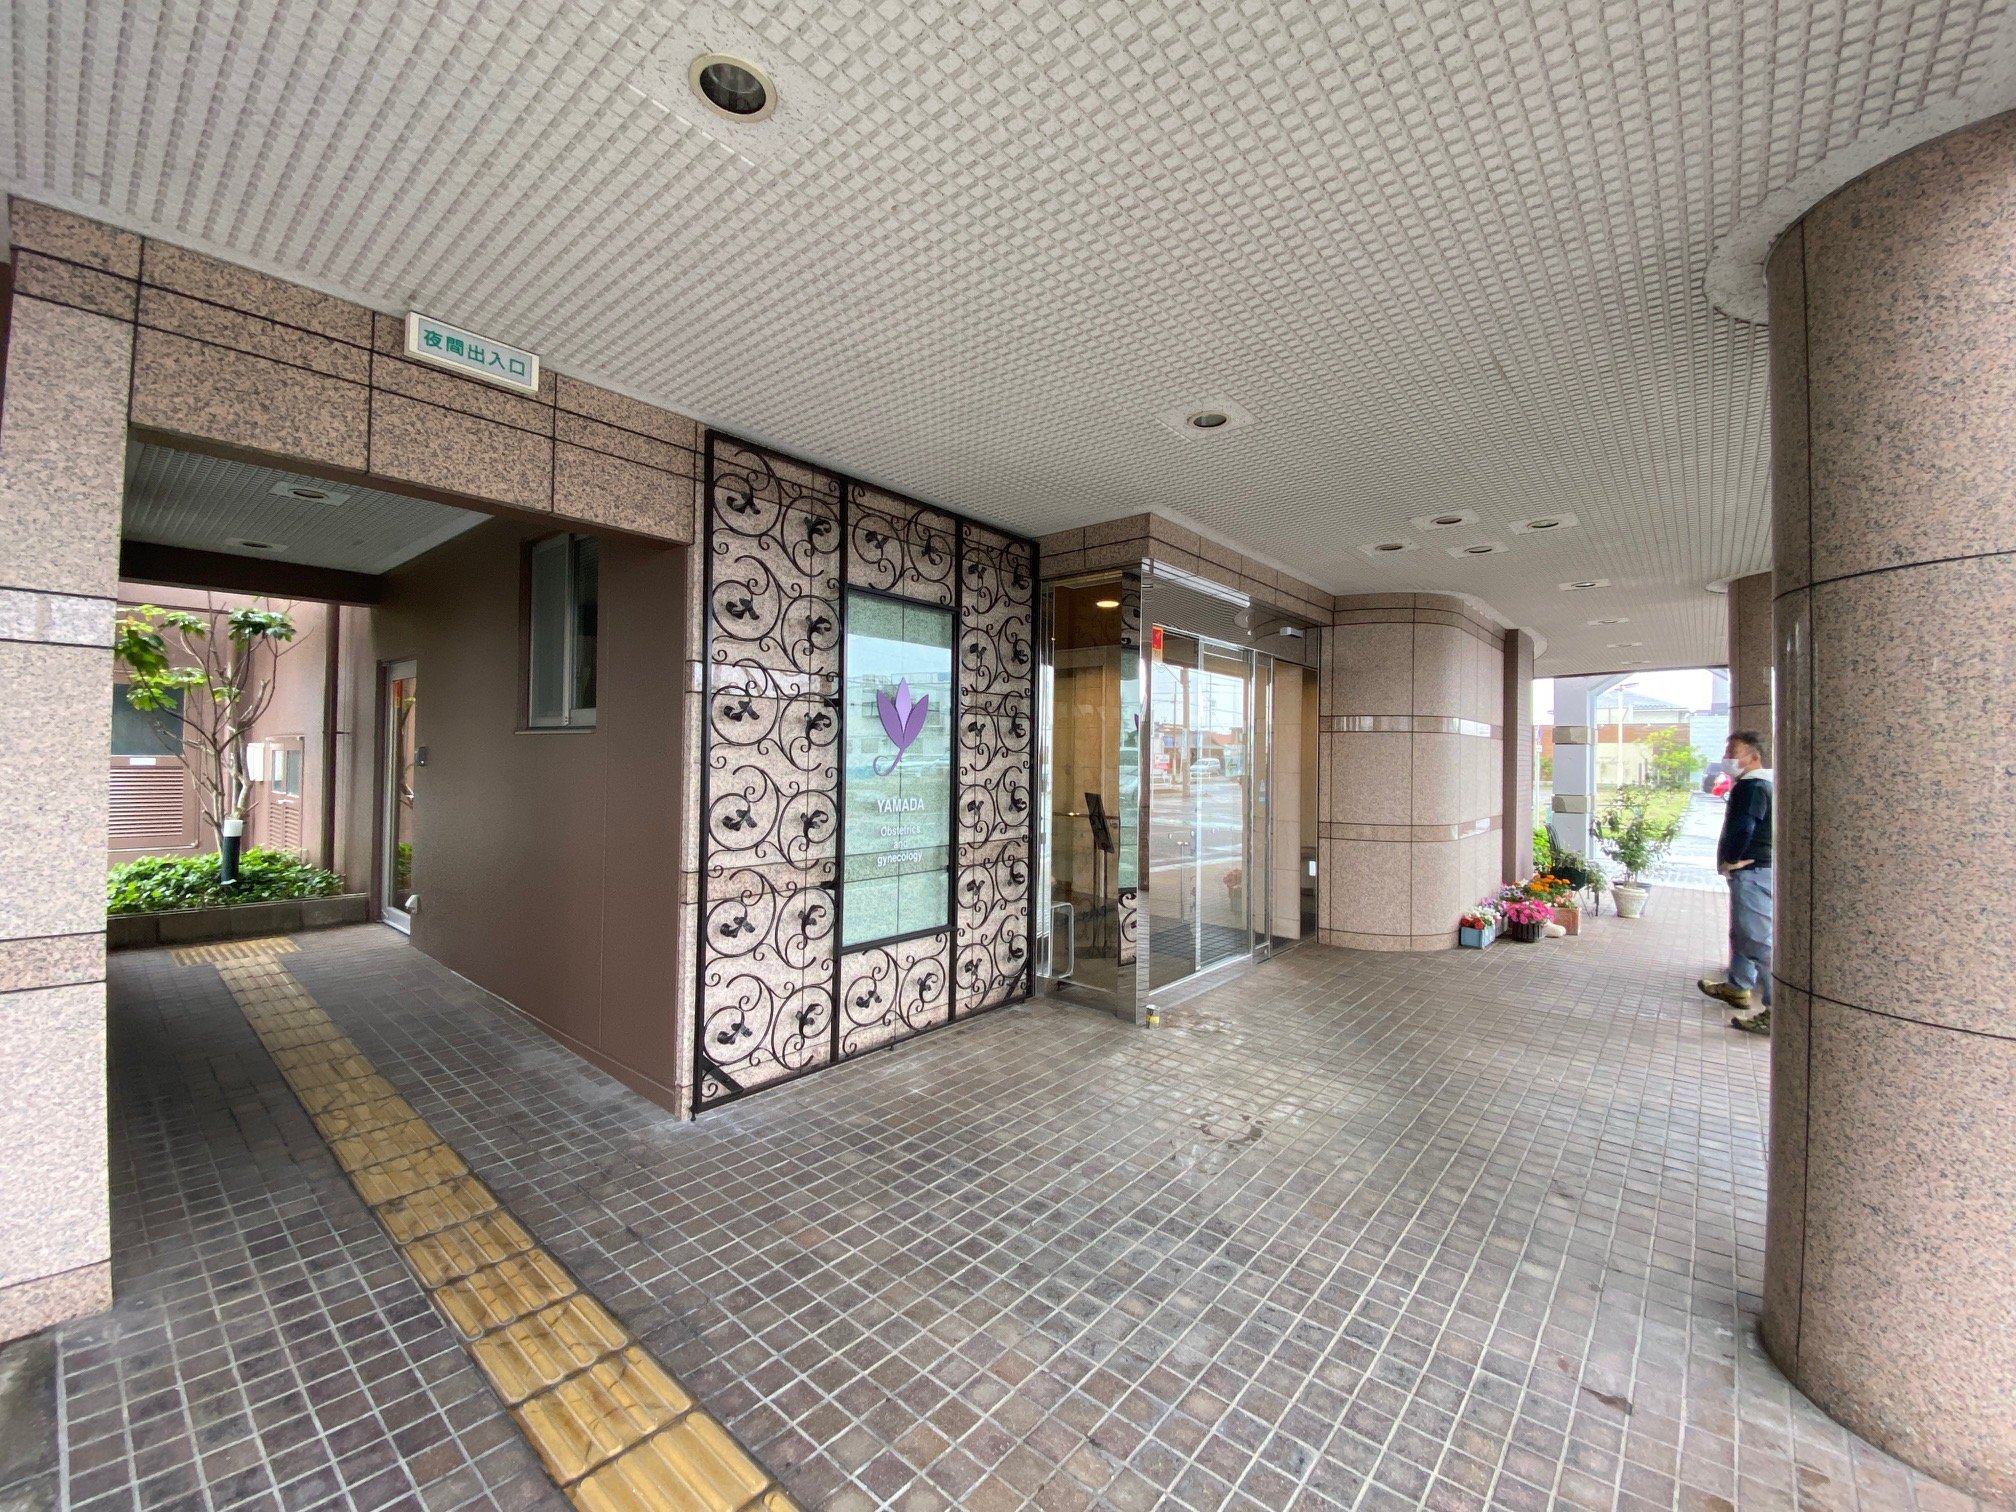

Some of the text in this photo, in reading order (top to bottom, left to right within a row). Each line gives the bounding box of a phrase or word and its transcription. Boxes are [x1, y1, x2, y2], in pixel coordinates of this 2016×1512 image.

[423, 329, 526, 377] 夜間出入口
[877, 798, 925, 813] YAMADA
[880, 824, 921, 837] Obstetrics
[877, 849, 923, 867] gynecology
